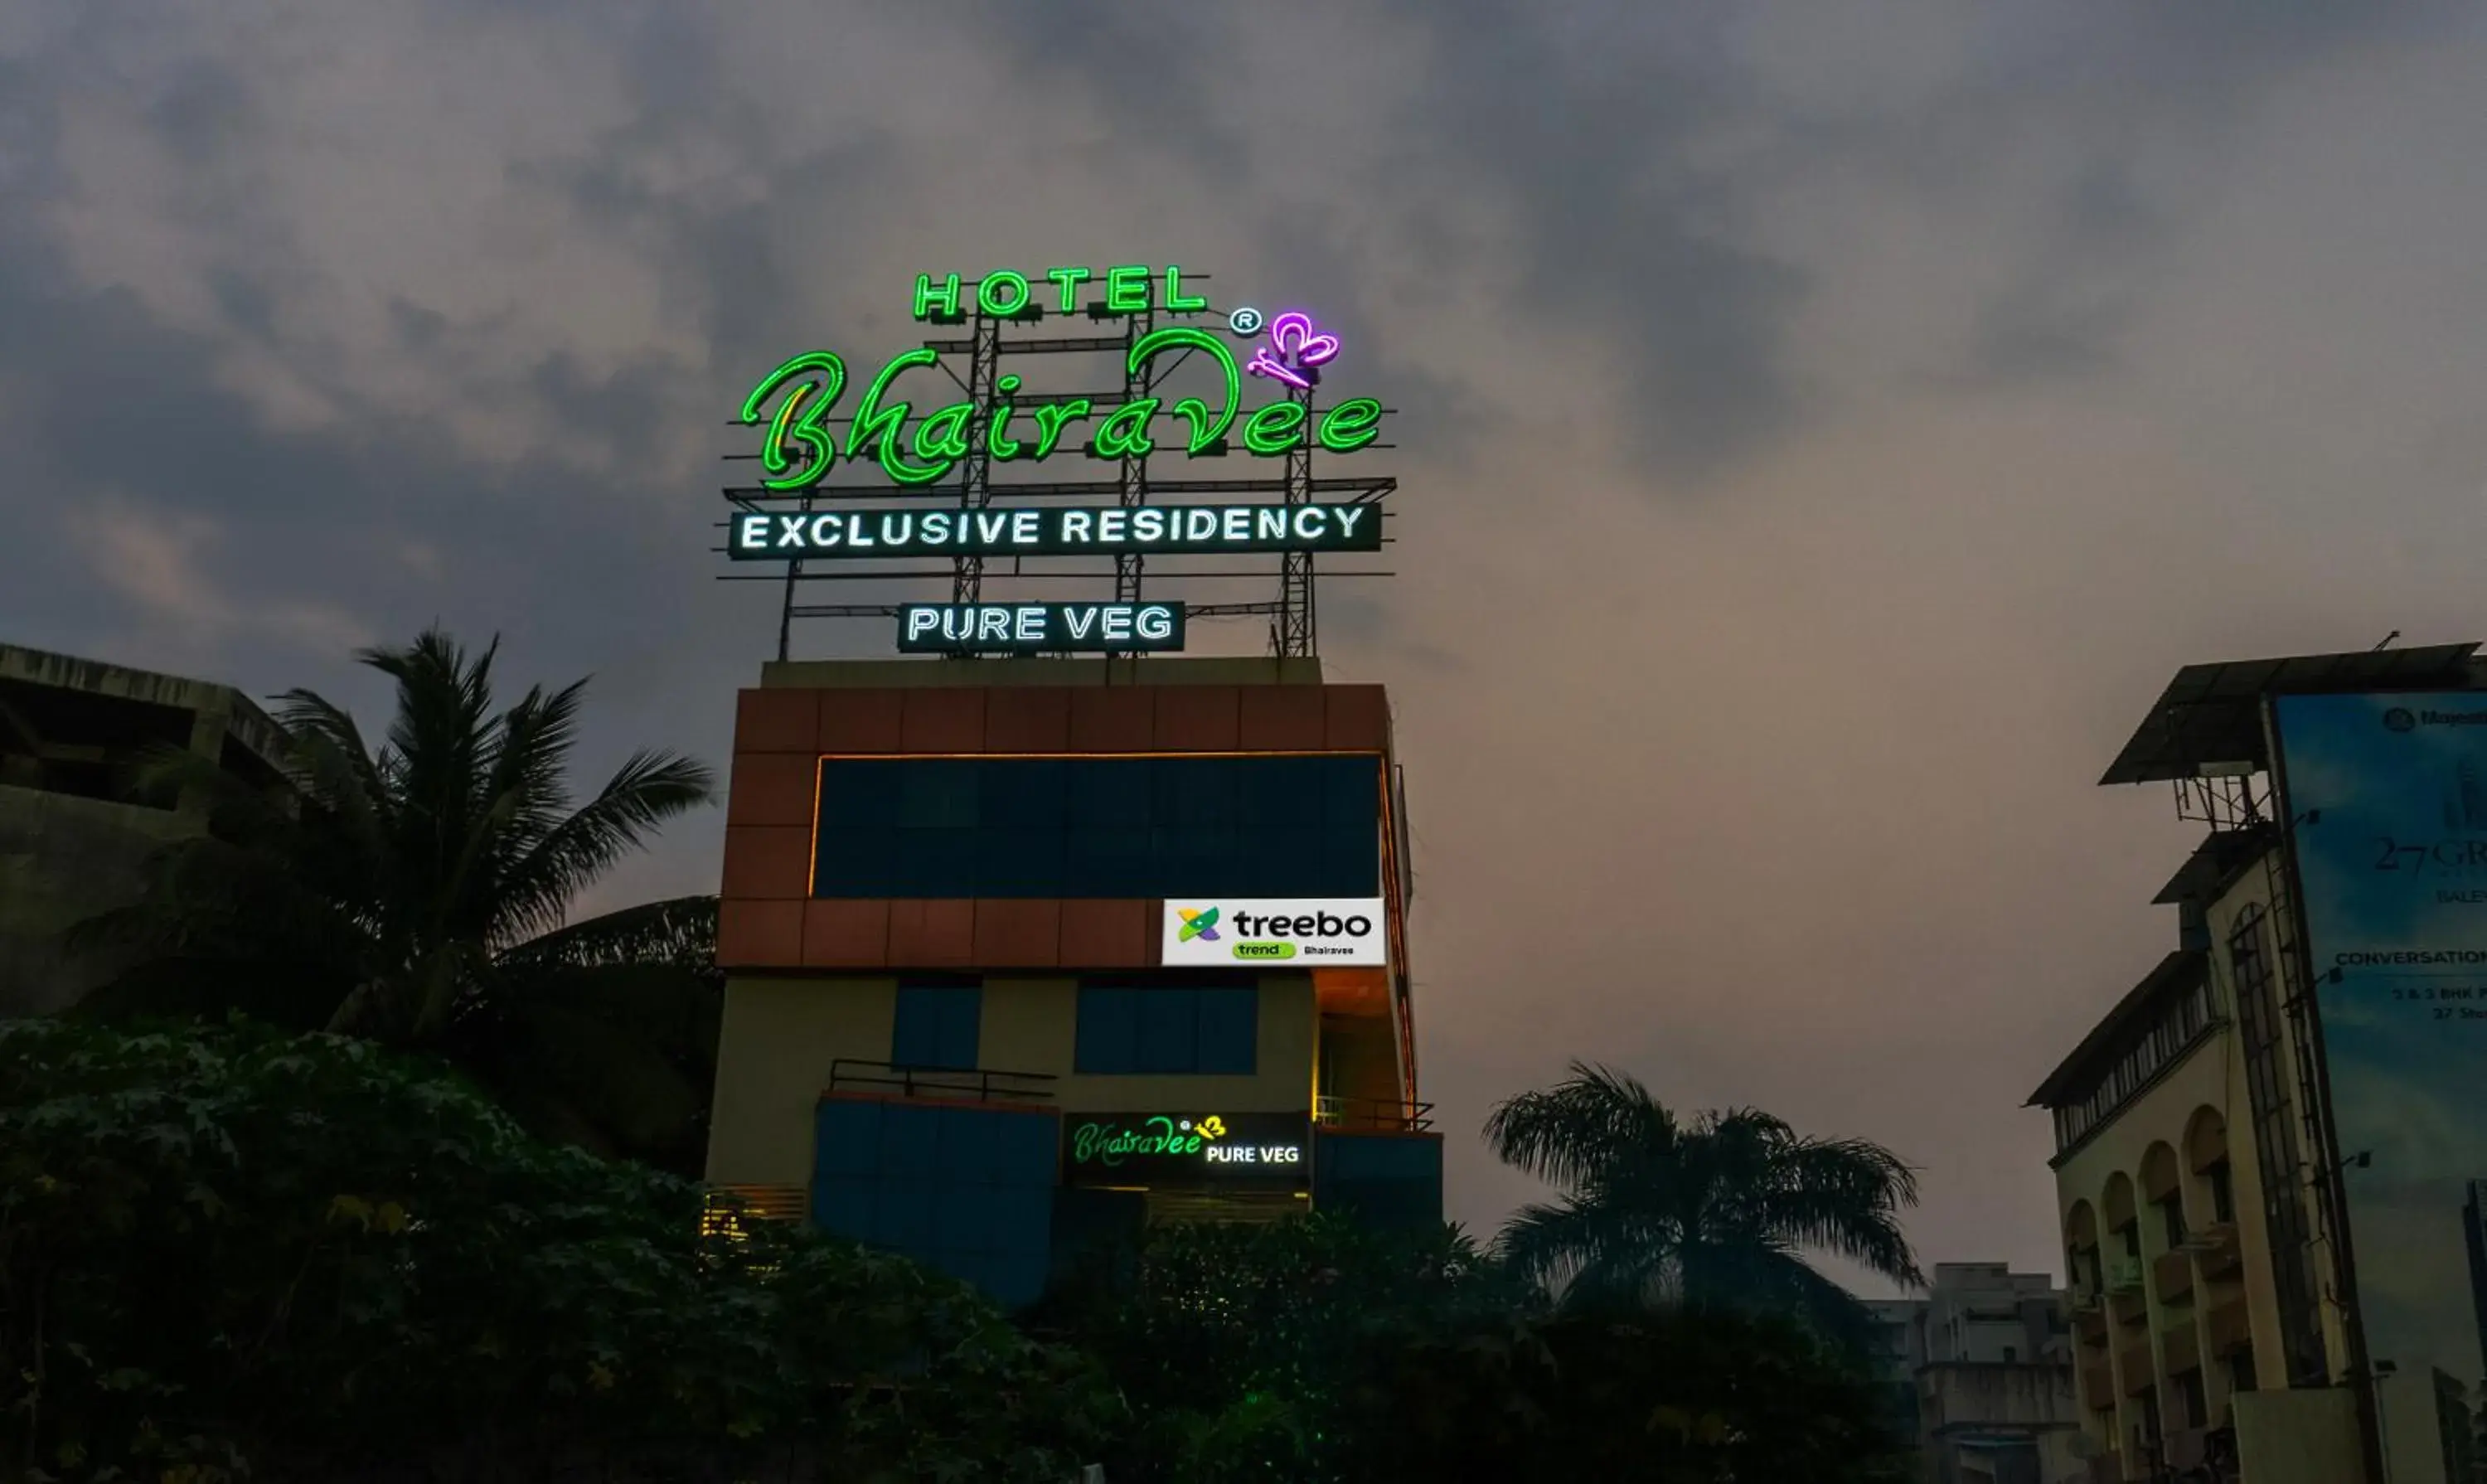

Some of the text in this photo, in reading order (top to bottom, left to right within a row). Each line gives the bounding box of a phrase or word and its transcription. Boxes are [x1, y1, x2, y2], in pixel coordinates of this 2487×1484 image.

[914, 265, 1207, 318] HOTEL
[742, 507, 1364, 549] EXCLUSIVE RESIDENCY
[908, 606, 1172, 642] PURE VEG
[1233, 910, 1372, 938] treebo
[1239, 944, 1279, 955] trend
[1304, 946, 1354, 956] Bhairavee
[1207, 1147, 1299, 1163] PURE VEG
